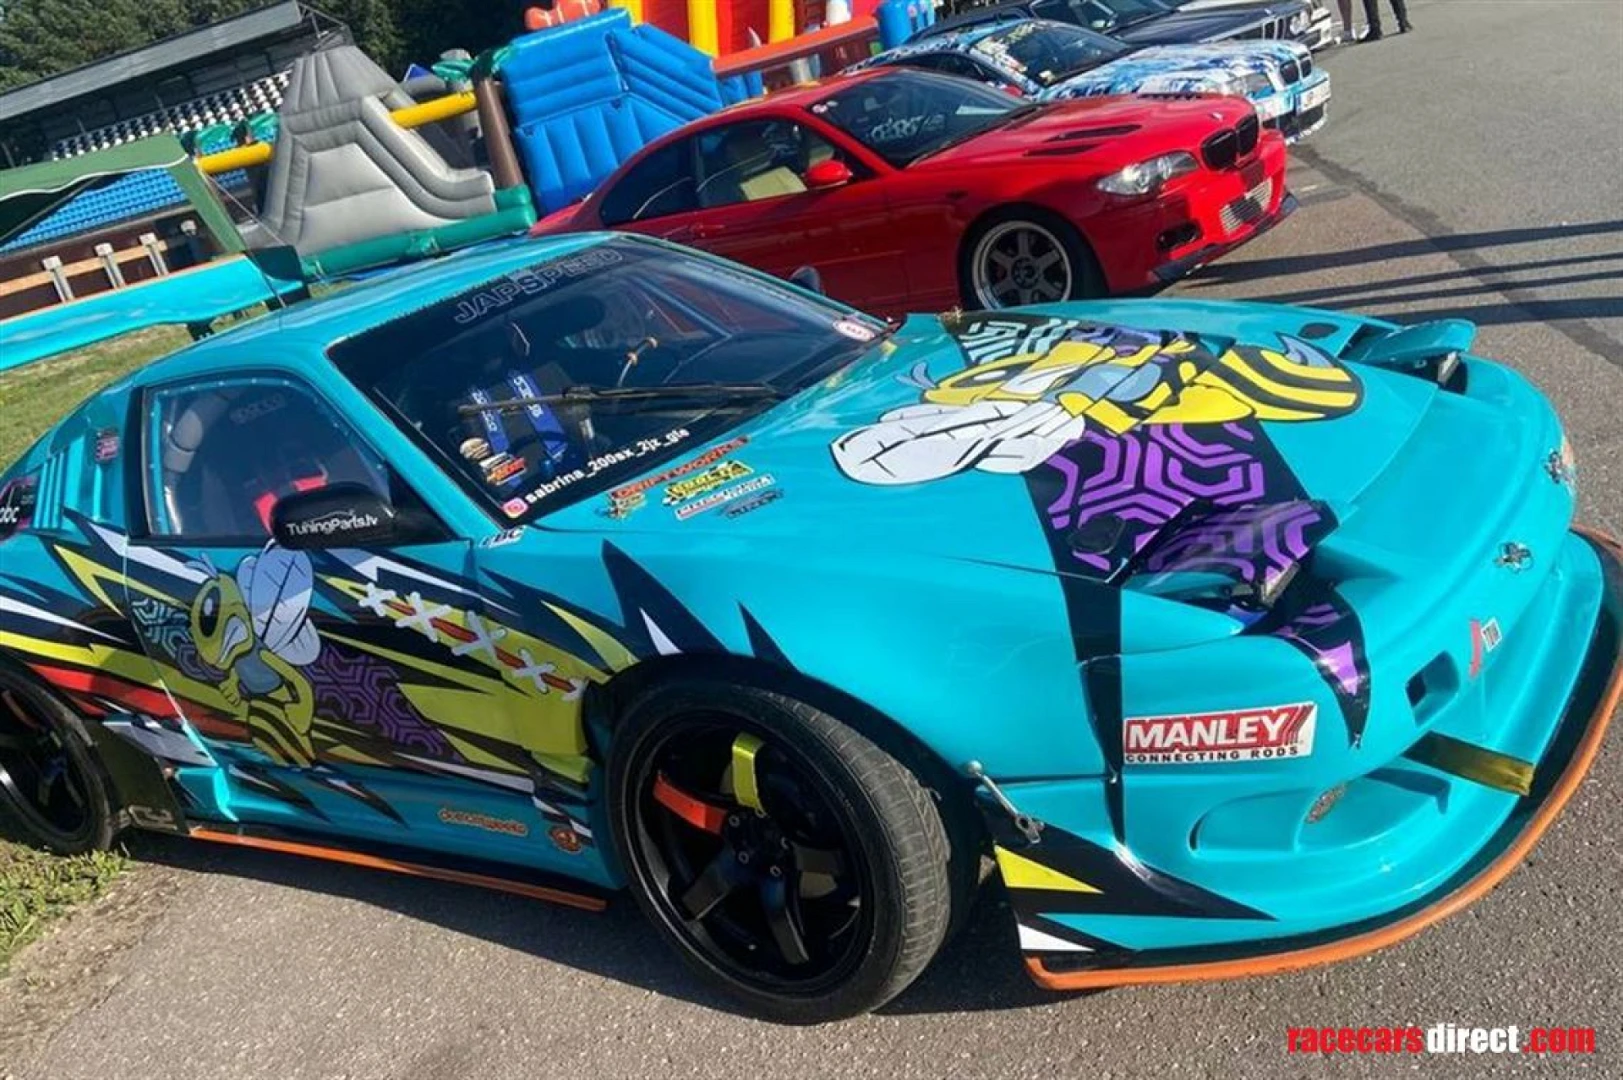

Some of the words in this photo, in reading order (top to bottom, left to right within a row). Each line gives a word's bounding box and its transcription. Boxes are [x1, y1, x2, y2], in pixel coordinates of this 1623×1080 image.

[454, 249, 623, 323] JAPSPEED
[1127, 711, 1290, 749] MANLEY
[1125, 750, 1241, 763] CONNECTING
[1250, 745, 1299, 758] RODS
